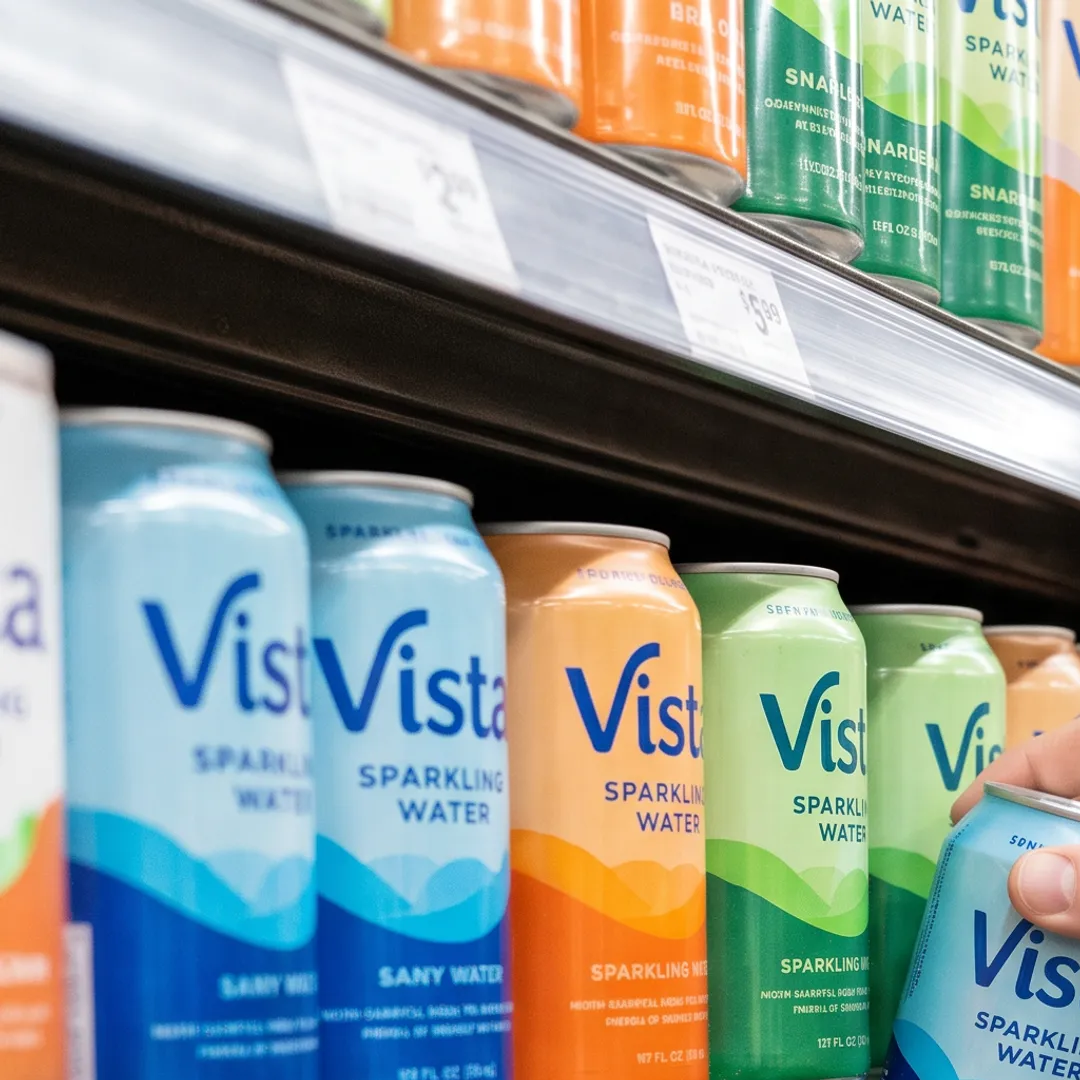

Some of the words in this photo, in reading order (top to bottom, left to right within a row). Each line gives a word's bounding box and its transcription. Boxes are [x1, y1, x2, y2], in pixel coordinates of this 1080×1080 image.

[870, 0, 928, 33] WATE
[565, 642, 704, 758] Vist
[358, 764, 504, 794] SPARKLING
[604, 780, 704, 806] SPARKLIN
[397, 799, 491, 825] WATER
[636, 811, 700, 834] WATER
[590, 961, 689, 982] SPARKLING
[780, 956, 860, 974] SPARKLING
